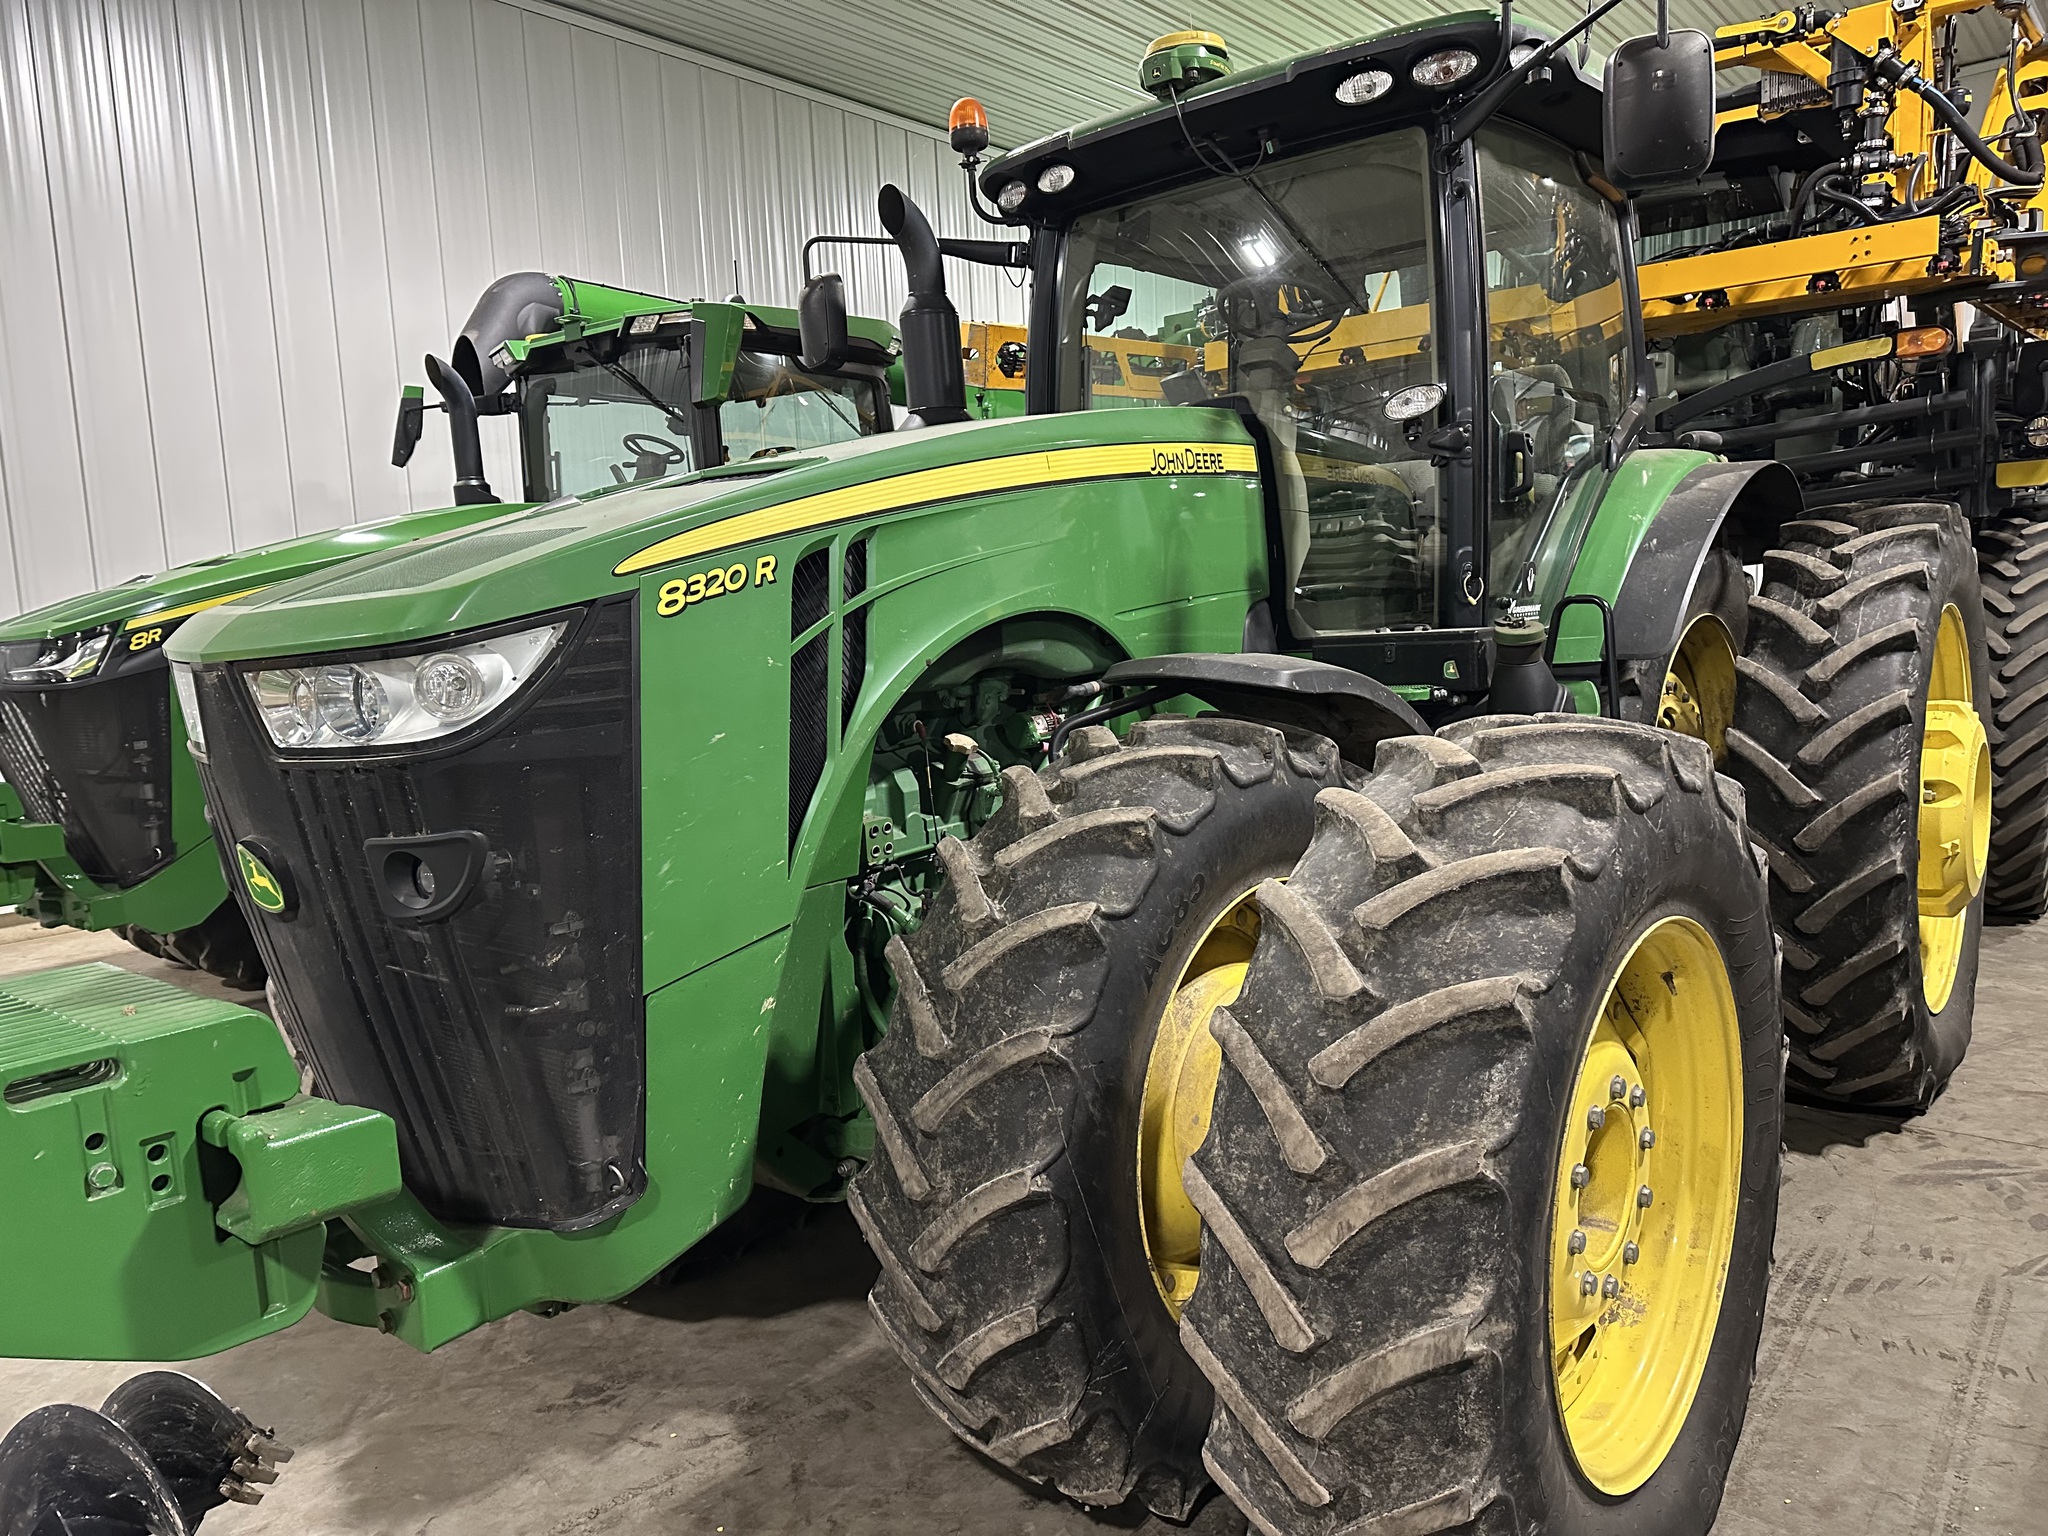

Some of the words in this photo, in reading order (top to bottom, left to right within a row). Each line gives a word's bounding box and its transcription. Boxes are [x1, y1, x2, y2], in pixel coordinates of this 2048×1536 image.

[1150, 448, 1185, 472] JOHN
[1185, 448, 1224, 470] DEERE
[656, 562, 749, 618] 8320
[754, 554, 778, 588] R
[129, 627, 163, 651] 8R
